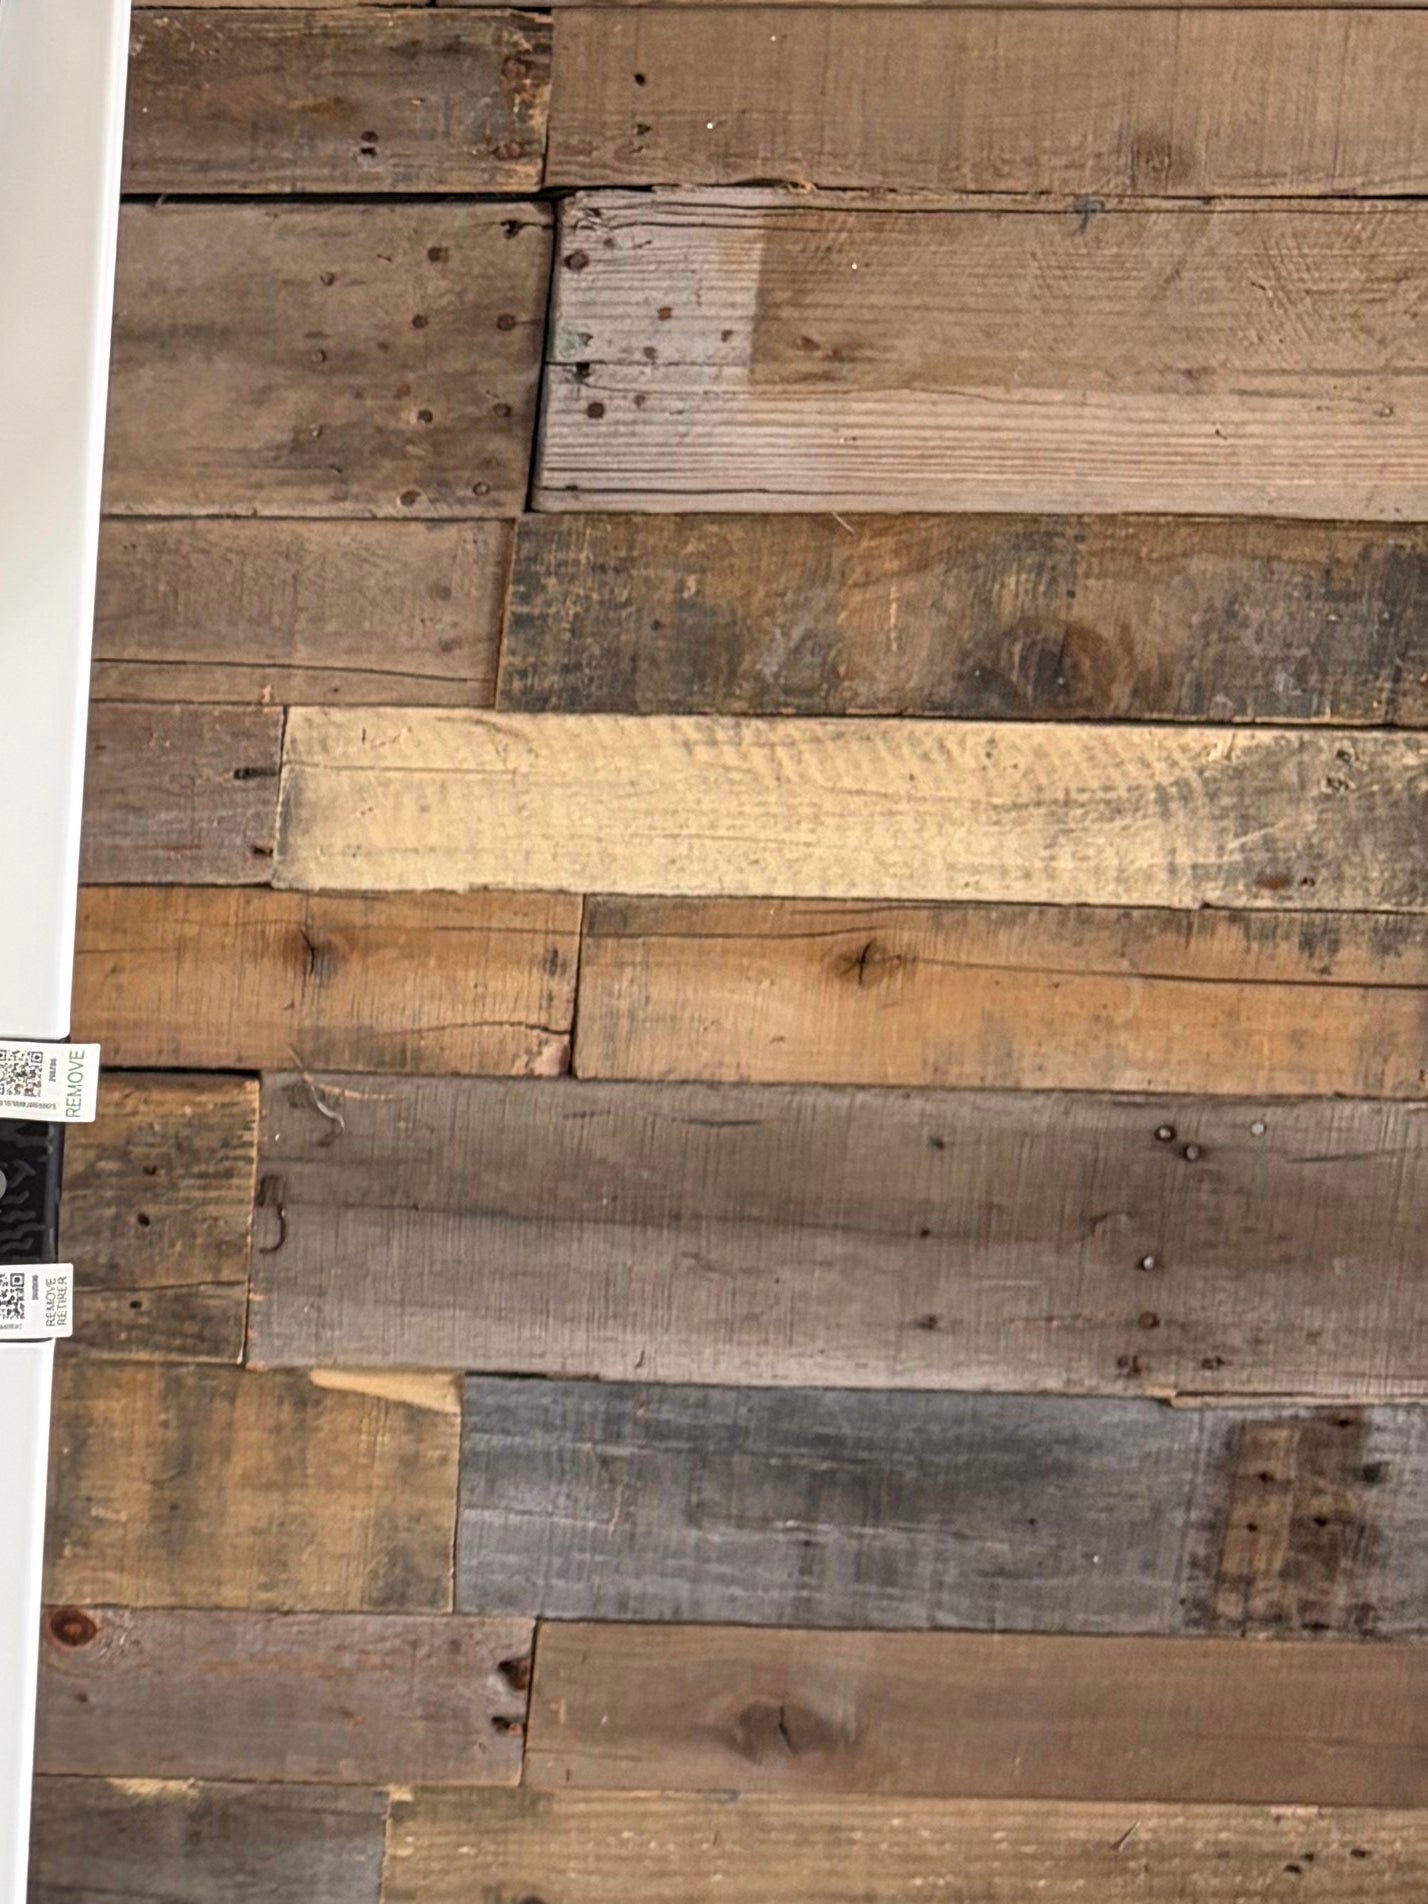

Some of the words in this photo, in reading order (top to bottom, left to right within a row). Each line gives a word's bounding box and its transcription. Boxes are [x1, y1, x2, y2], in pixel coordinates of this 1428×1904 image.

[65, 1050, 85, 1118] REMOVE
[45, 1277, 56, 1327] REMOVE
[57, 1276, 67, 1325] RETIRER
